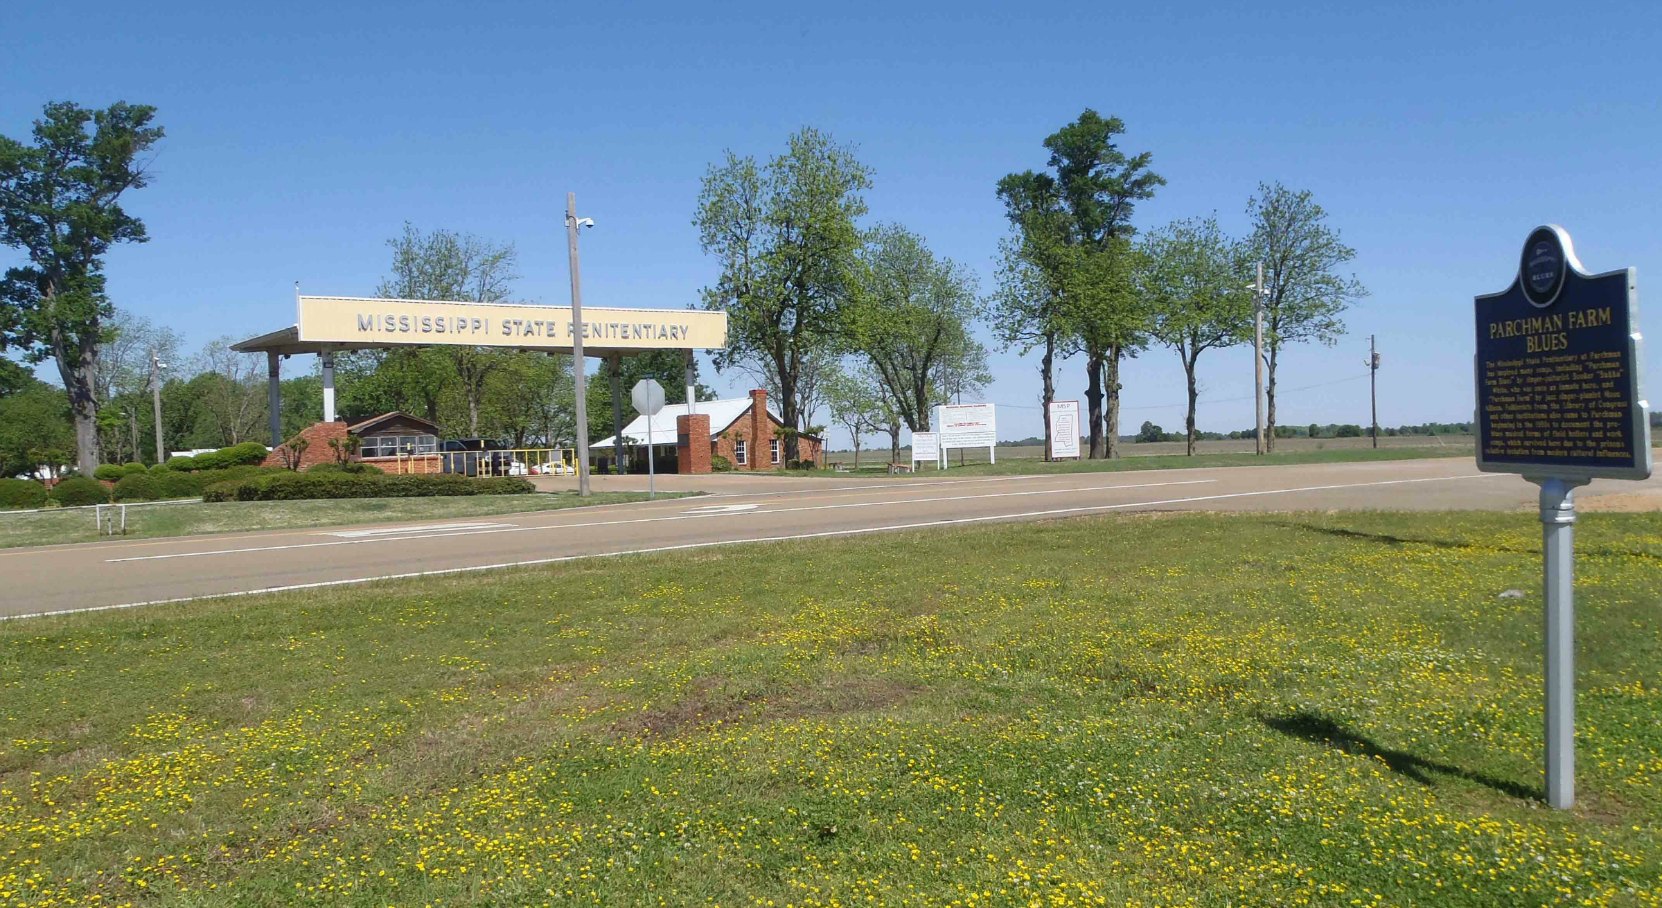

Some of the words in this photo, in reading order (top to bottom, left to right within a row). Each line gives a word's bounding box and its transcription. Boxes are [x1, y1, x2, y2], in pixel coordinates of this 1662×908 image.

[357, 313, 489, 335] MISSISSIPPI
[501, 318, 556, 337] STATE
[1489, 313, 1562, 339] PARCHMAN
[1568, 307, 1611, 329] FARM
[1527, 332, 1568, 353] BLUES
